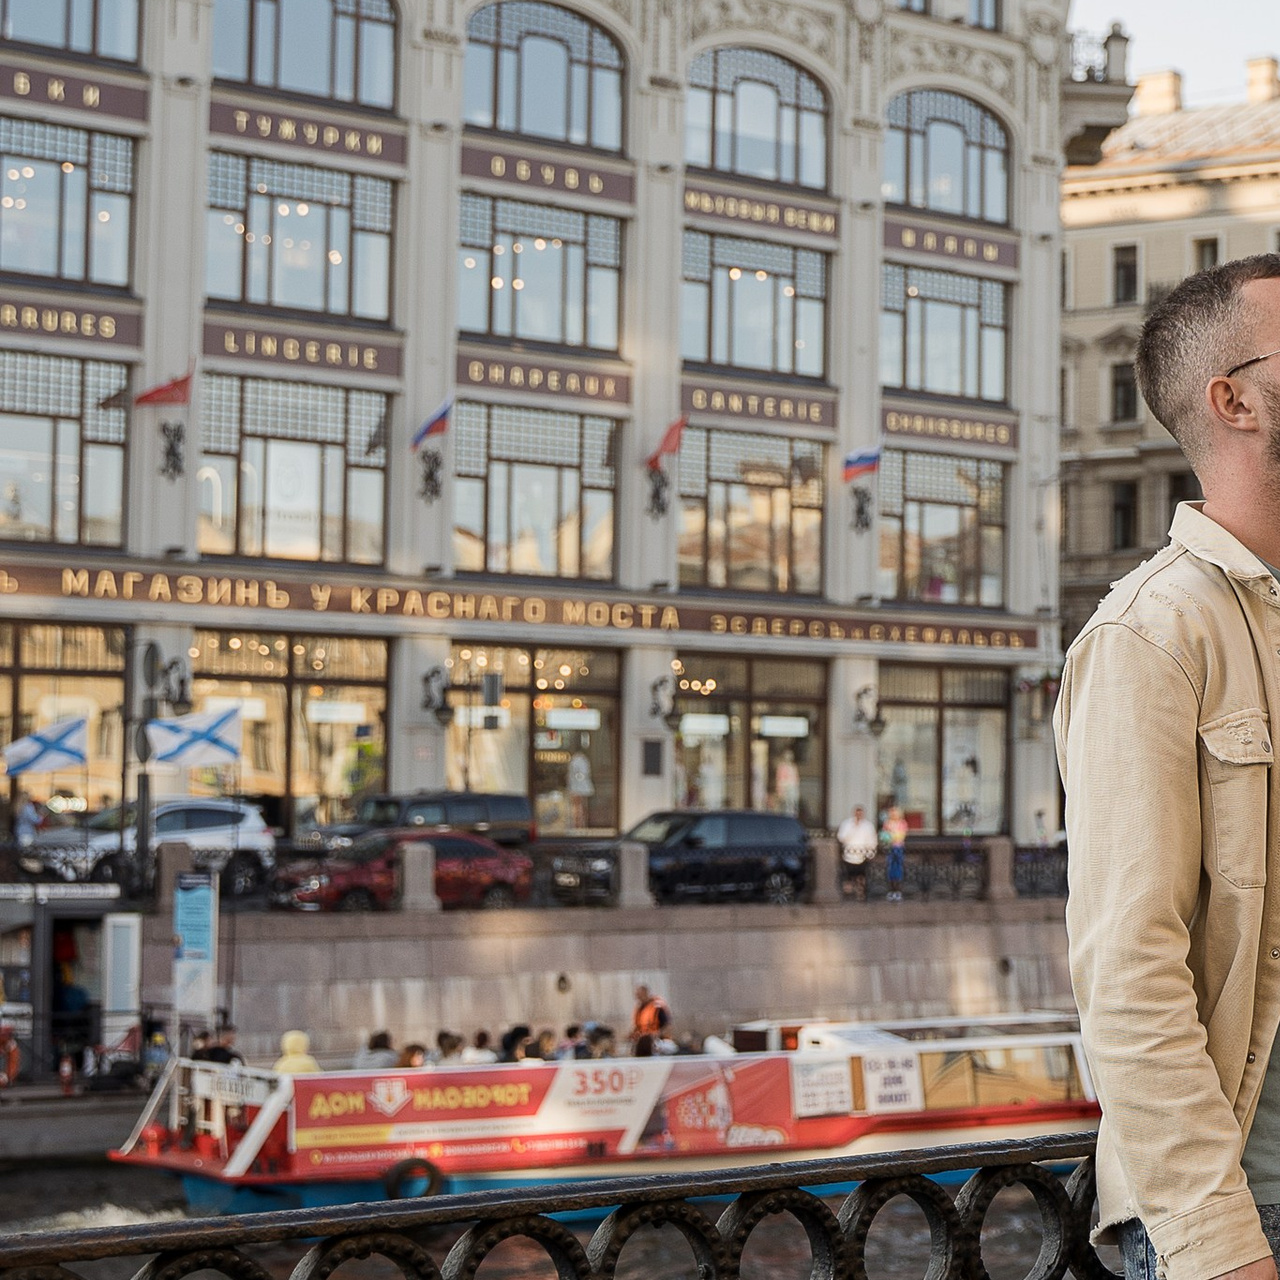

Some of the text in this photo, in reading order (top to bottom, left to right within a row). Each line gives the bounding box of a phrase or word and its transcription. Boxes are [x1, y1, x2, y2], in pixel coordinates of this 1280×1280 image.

[224, 330, 378, 370] LINGERIE
[468, 361, 616, 398] CHAPEAUX
[692, 389, 823, 422] GANTERIE
[62, 568, 291, 609] МАГАЗИНЪ
[310, 583, 332, 611] У
[351, 586, 547, 624] КРАСНАГО
[562, 600, 681, 630] МОСТА
[308, 1091, 366, 1120] ДОМ
